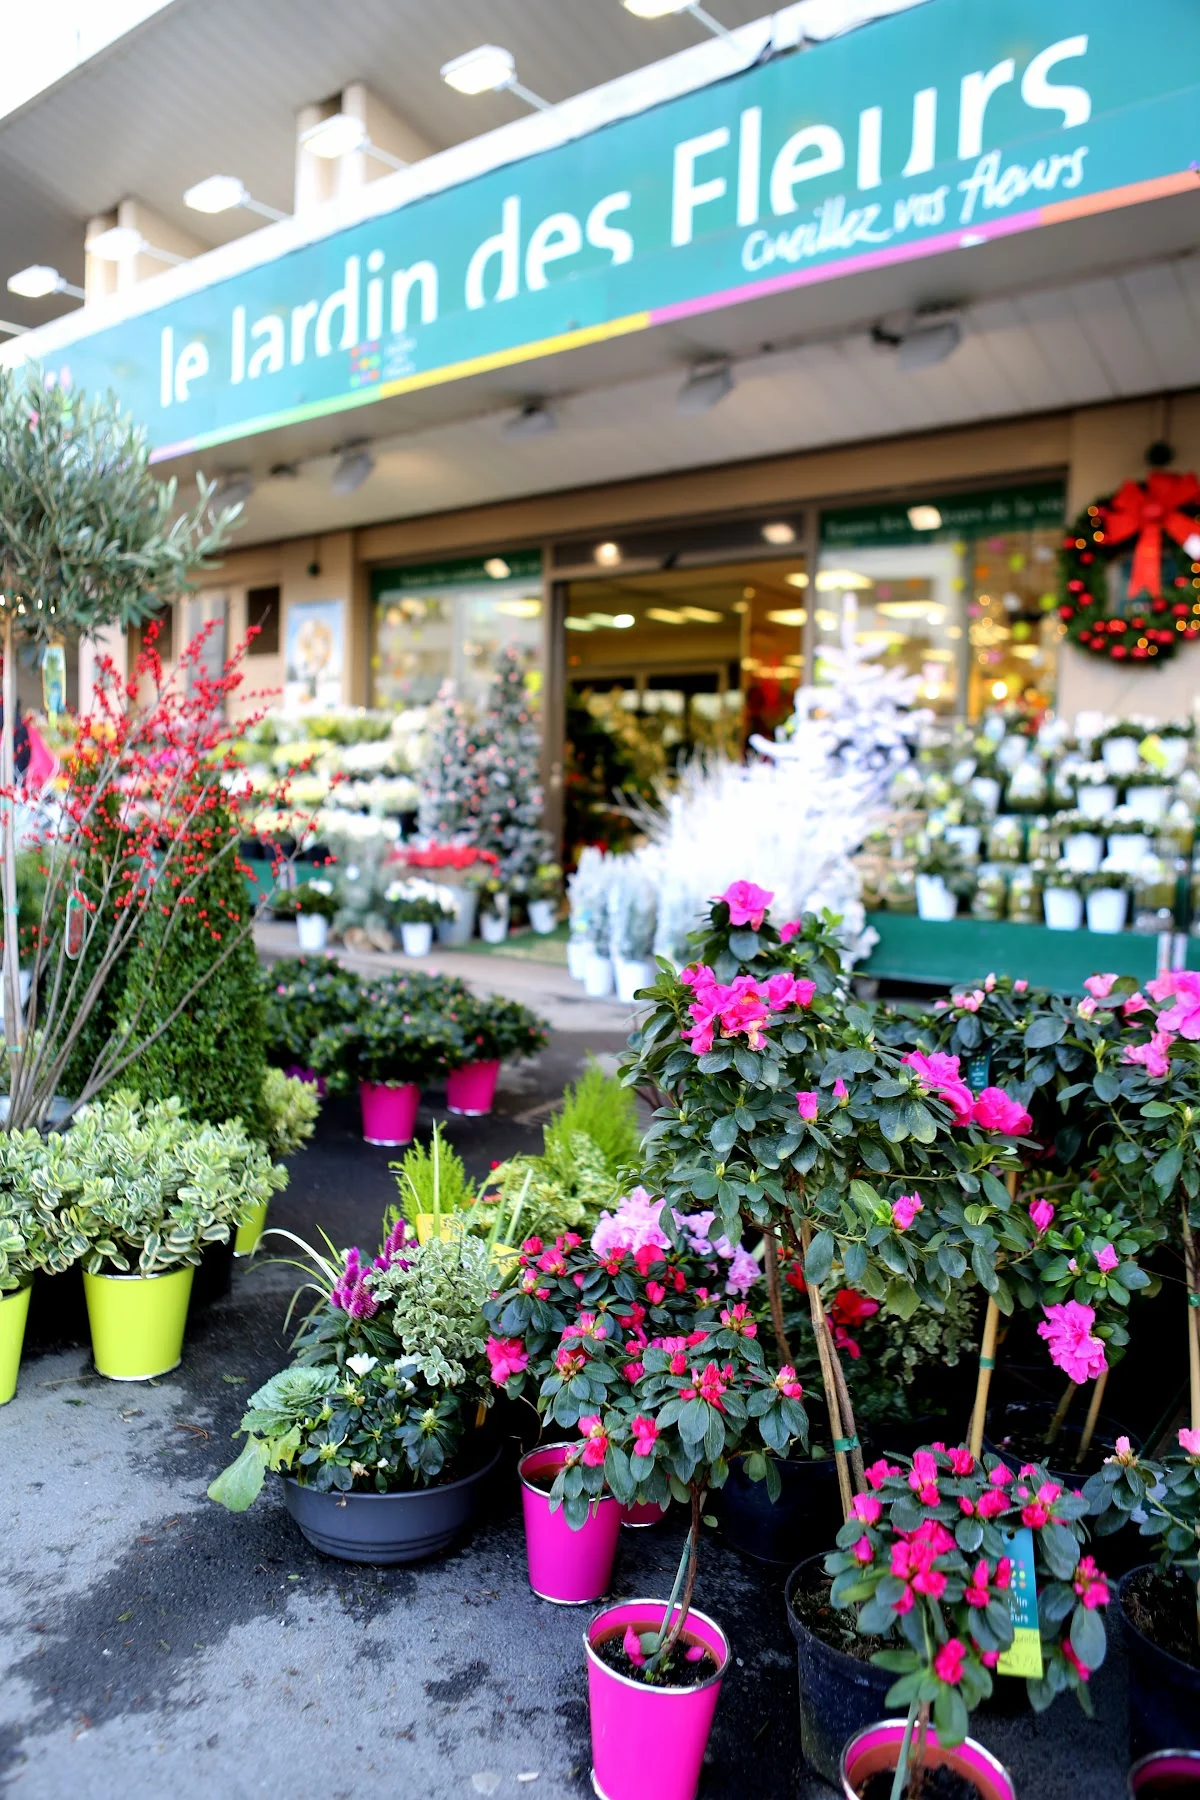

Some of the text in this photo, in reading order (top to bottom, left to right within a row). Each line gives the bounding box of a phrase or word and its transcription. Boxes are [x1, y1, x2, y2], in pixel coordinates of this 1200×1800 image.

[160, 325, 209, 409] le
[465, 195, 634, 312] des
[671, 34, 1093, 247] Fleurs
[893, 185, 951, 232] vos
[957, 146, 1090, 225] fleurs
